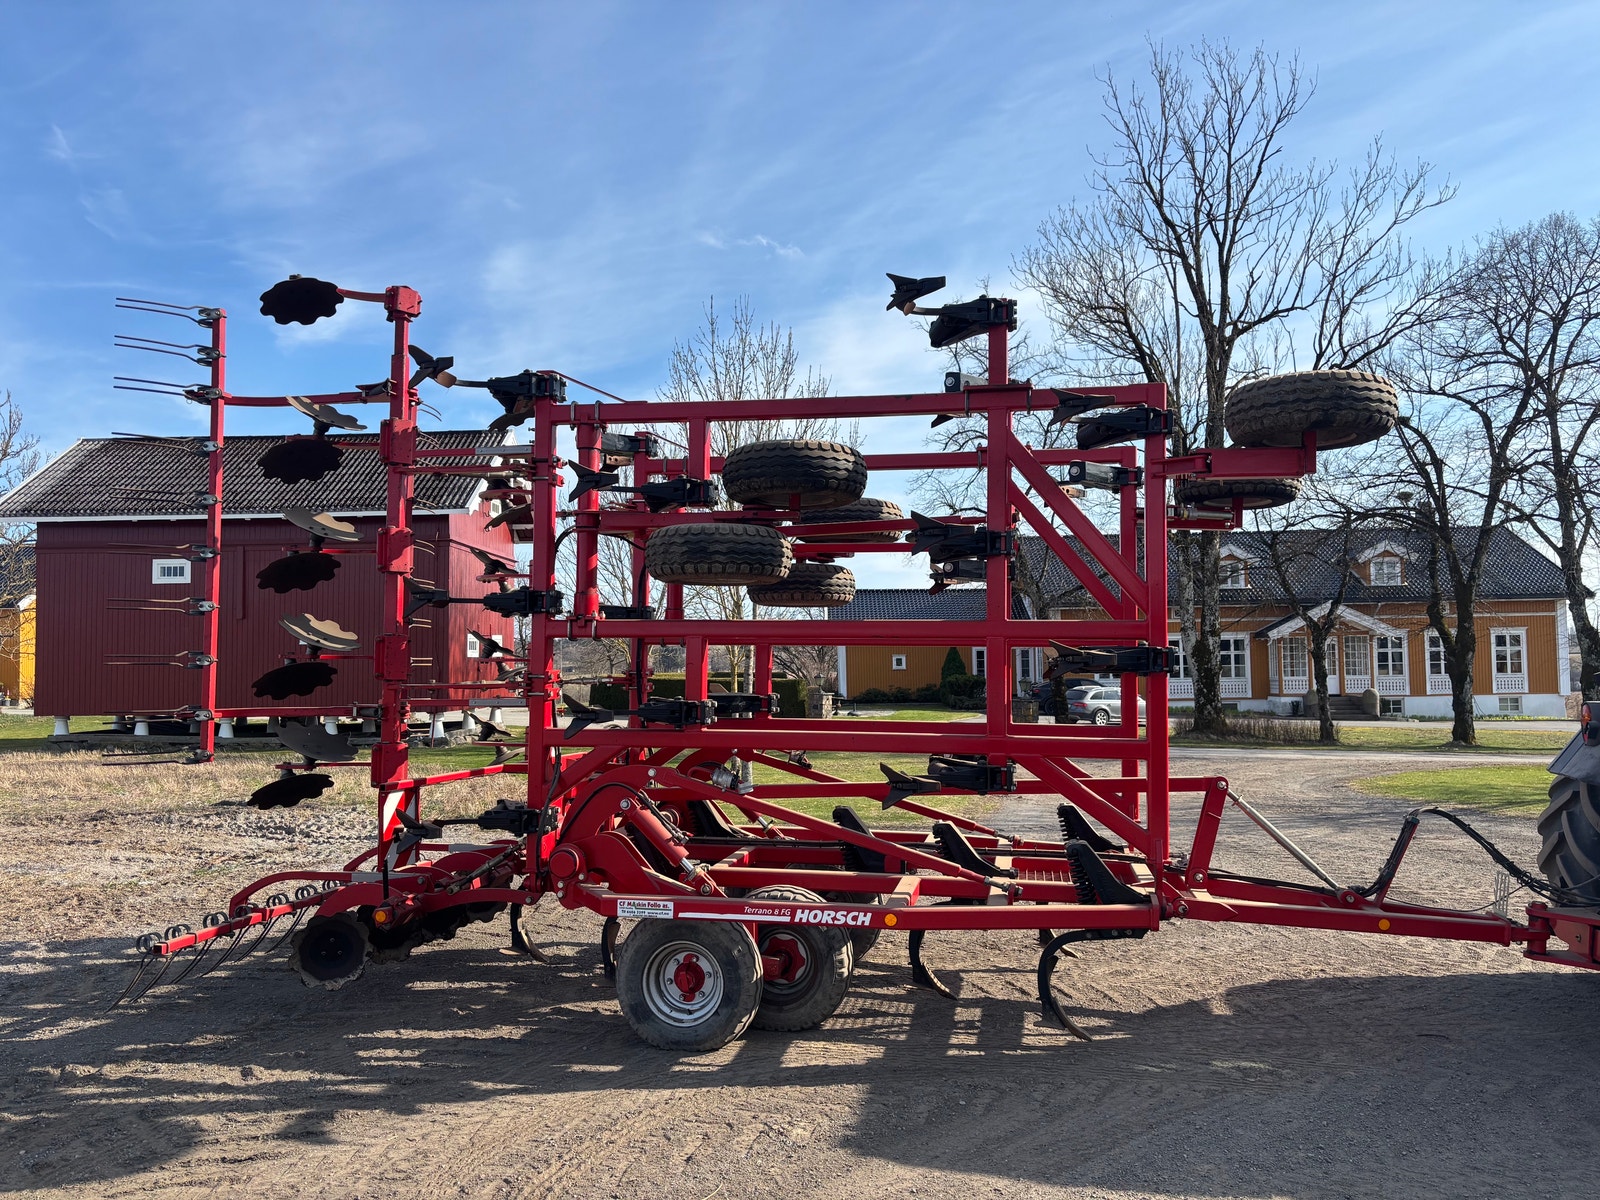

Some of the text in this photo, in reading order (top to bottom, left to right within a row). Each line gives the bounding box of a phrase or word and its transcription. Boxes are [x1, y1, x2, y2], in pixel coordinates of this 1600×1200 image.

[744, 906, 772, 915] Terrano
[780, 908, 791, 916] FG
[794, 909, 872, 926] HORSCH
